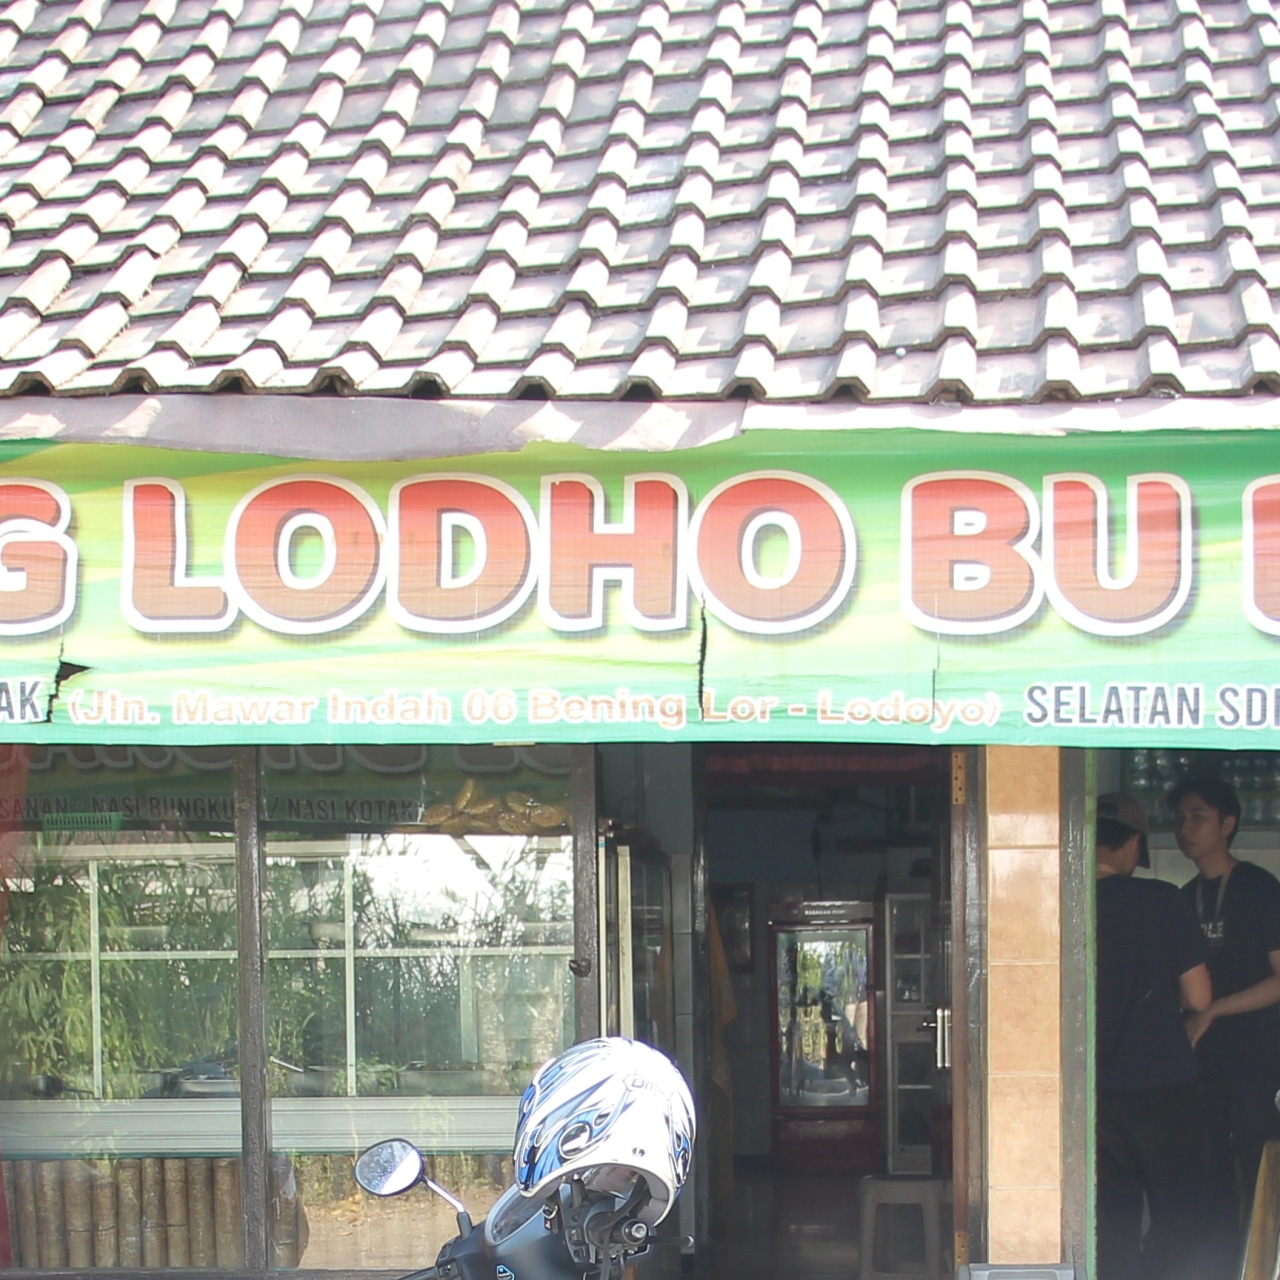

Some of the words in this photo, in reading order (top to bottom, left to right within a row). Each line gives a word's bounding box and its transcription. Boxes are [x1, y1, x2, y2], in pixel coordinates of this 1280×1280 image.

[122, 472, 856, 635] LODHO
[902, 473, 1194, 637] BU
[173, 691, 318, 725] Mawar
[328, 688, 450, 725] Indah
[463, 691, 518, 725] 06
[529, 689, 686, 731] Bening
[702, 690, 779, 724] Lor
[817, 689, 1001, 733] Lodoyo)
[1025, 682, 1204, 727] SELATAN
[148, 796, 233, 821] BUNGKU
